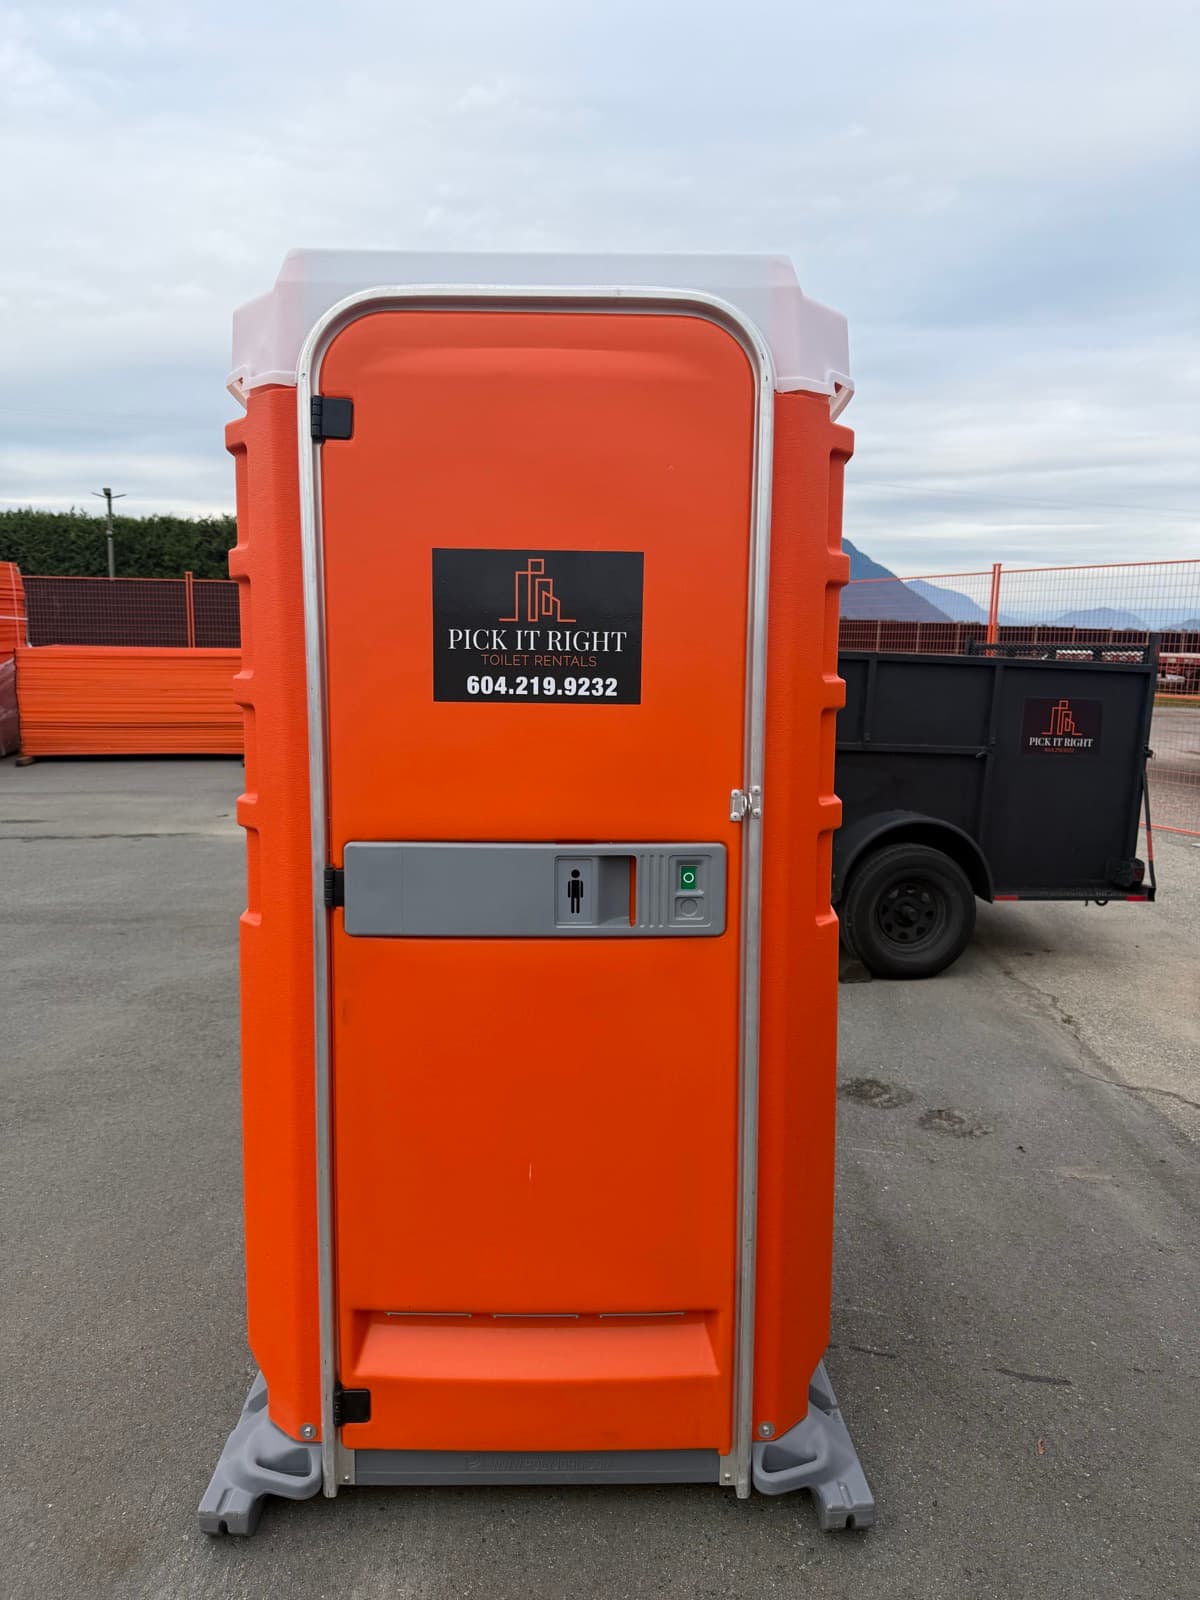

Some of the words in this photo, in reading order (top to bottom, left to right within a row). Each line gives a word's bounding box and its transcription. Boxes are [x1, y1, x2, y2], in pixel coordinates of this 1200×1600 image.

[448, 628, 508, 651] PICK
[515, 629, 541, 651] IT
[547, 630, 627, 652] RIGHT
[481, 653, 530, 667] TOILET
[534, 654, 597, 667] RENTALS
[466, 675, 618, 696] 604.219.9232
[1029, 736, 1051, 747] PICK
[1052, 737, 1063, 747] IT
[1064, 737, 1093, 747] RIGHT
